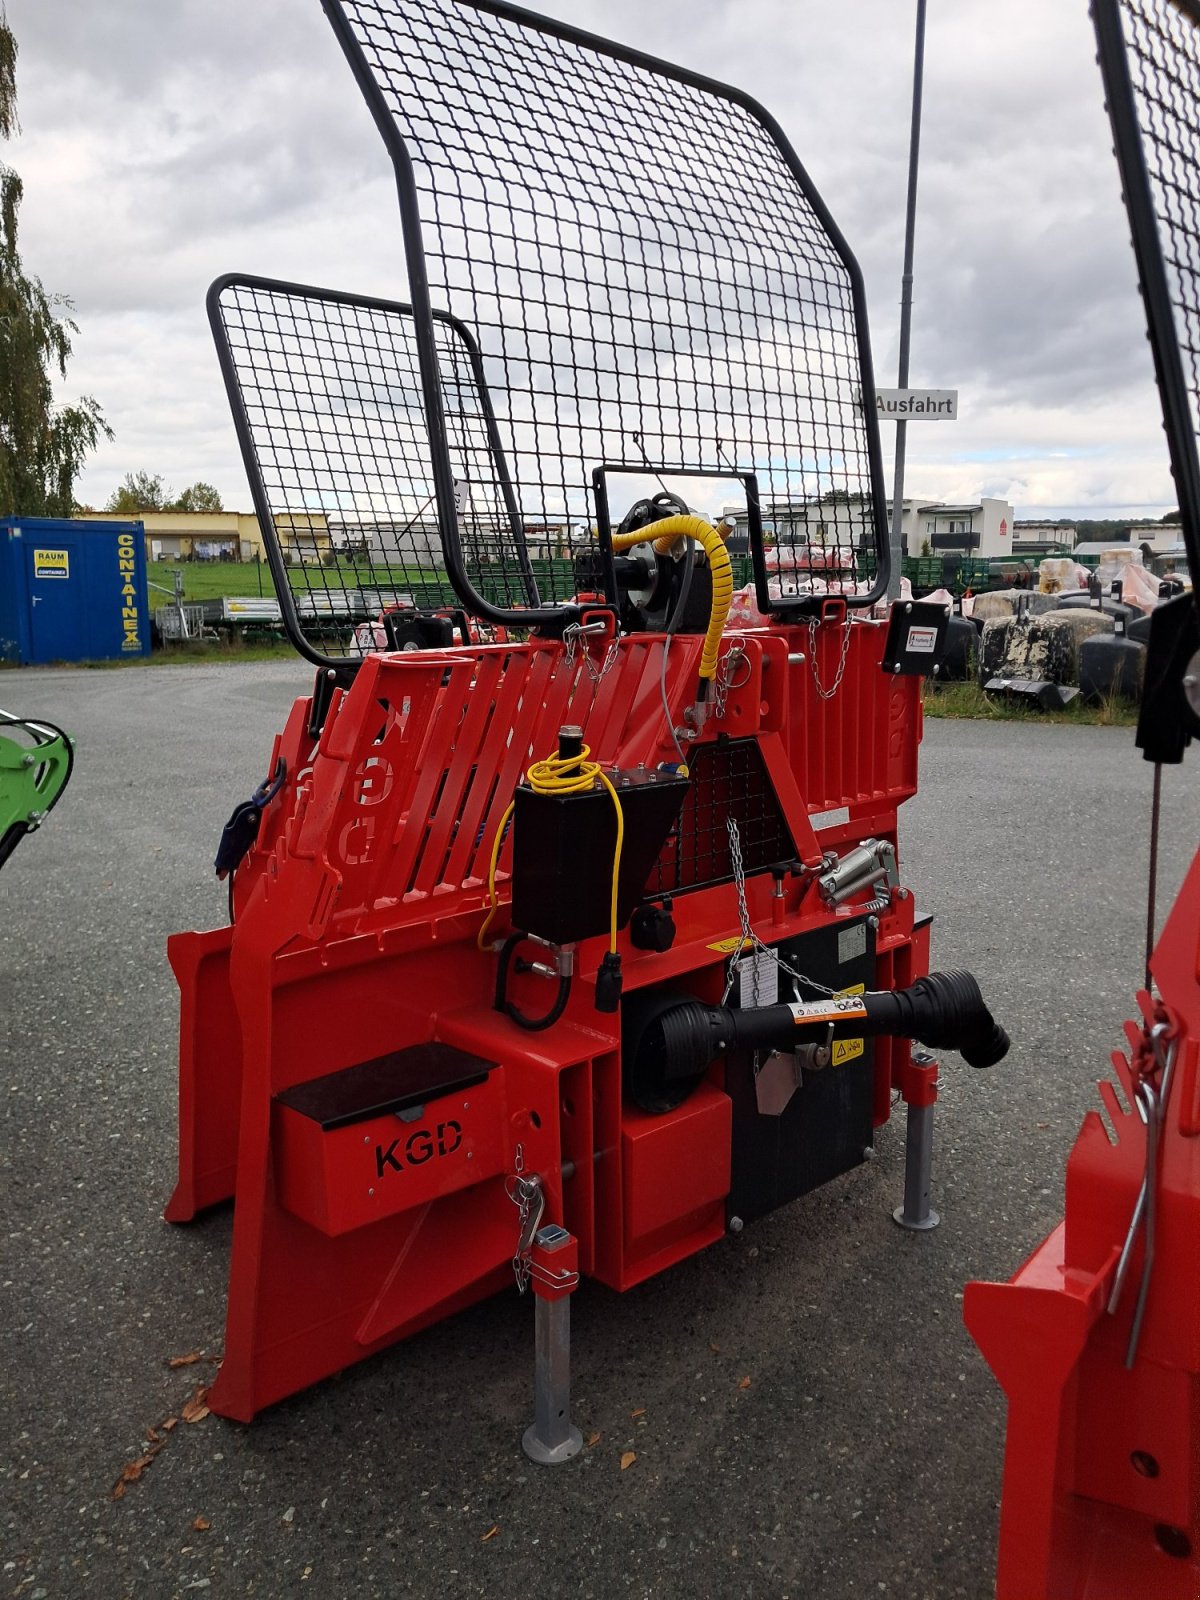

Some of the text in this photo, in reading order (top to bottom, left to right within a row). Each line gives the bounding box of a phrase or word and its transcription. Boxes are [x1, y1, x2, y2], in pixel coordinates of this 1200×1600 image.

[876, 395, 953, 413] Ausfahrt
[118, 535, 140, 642] CONTAINEX
[376, 1120, 462, 1178] KGD
